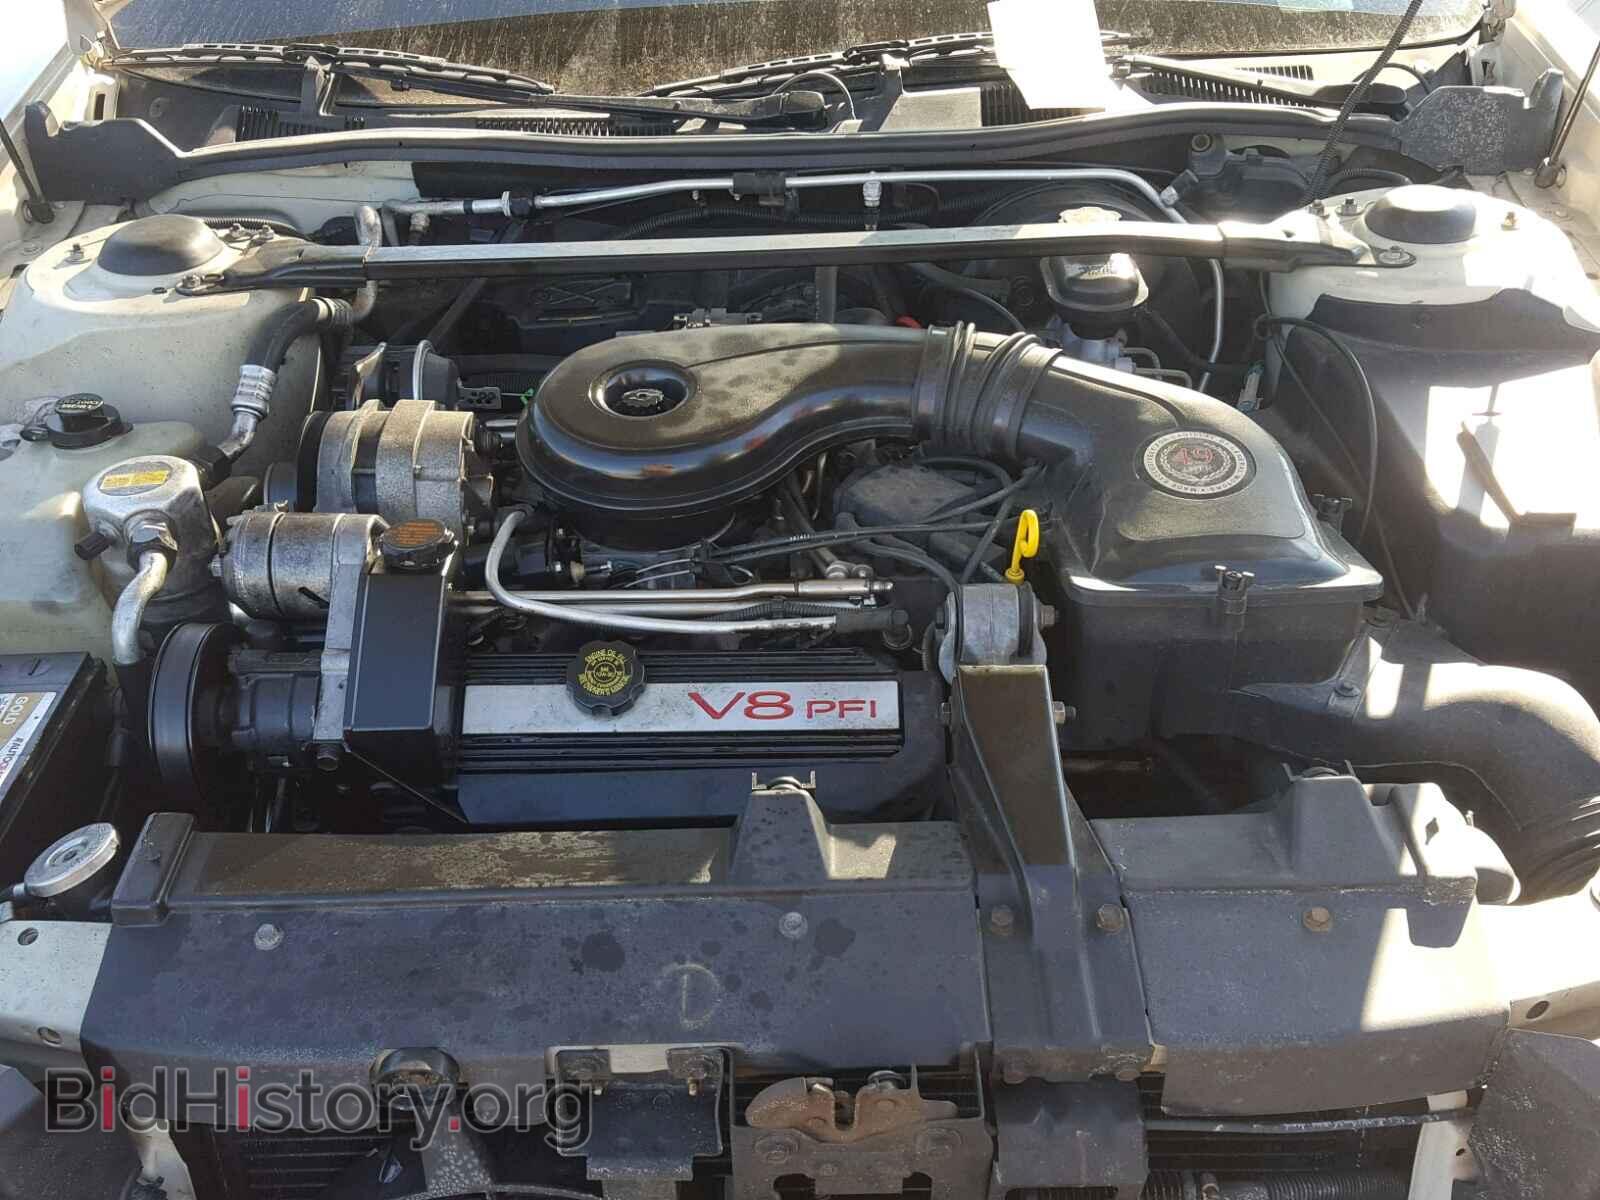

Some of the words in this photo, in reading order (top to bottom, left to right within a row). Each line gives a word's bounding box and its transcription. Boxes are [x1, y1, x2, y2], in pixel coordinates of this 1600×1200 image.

[3, 696, 29, 725] GOLD
[688, 690, 794, 720] V8
[806, 700, 877, 719] PFI
